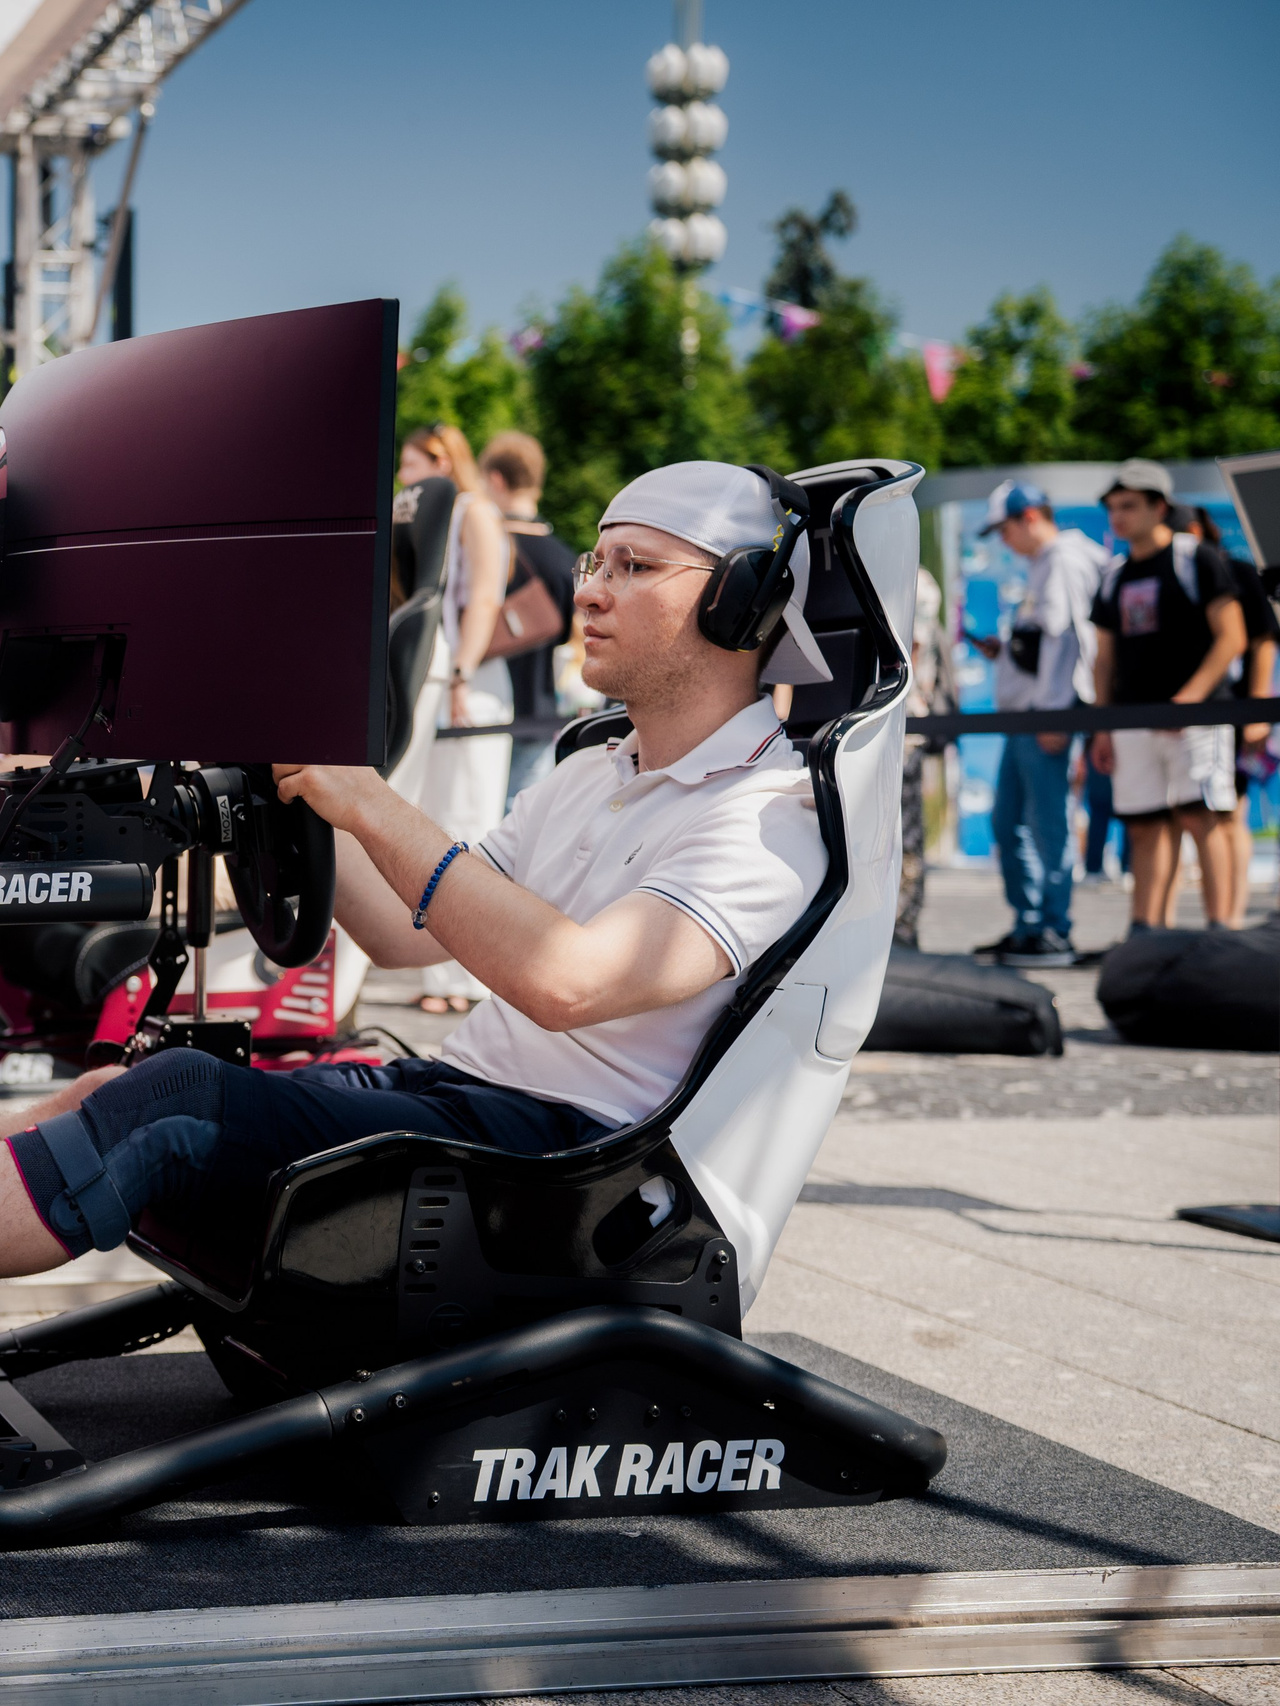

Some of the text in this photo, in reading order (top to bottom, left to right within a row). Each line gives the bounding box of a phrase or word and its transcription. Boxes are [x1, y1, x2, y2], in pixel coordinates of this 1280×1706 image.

[220, 799, 230, 840] MOZA
[473, 1438, 785, 1502] TRAK RACER
